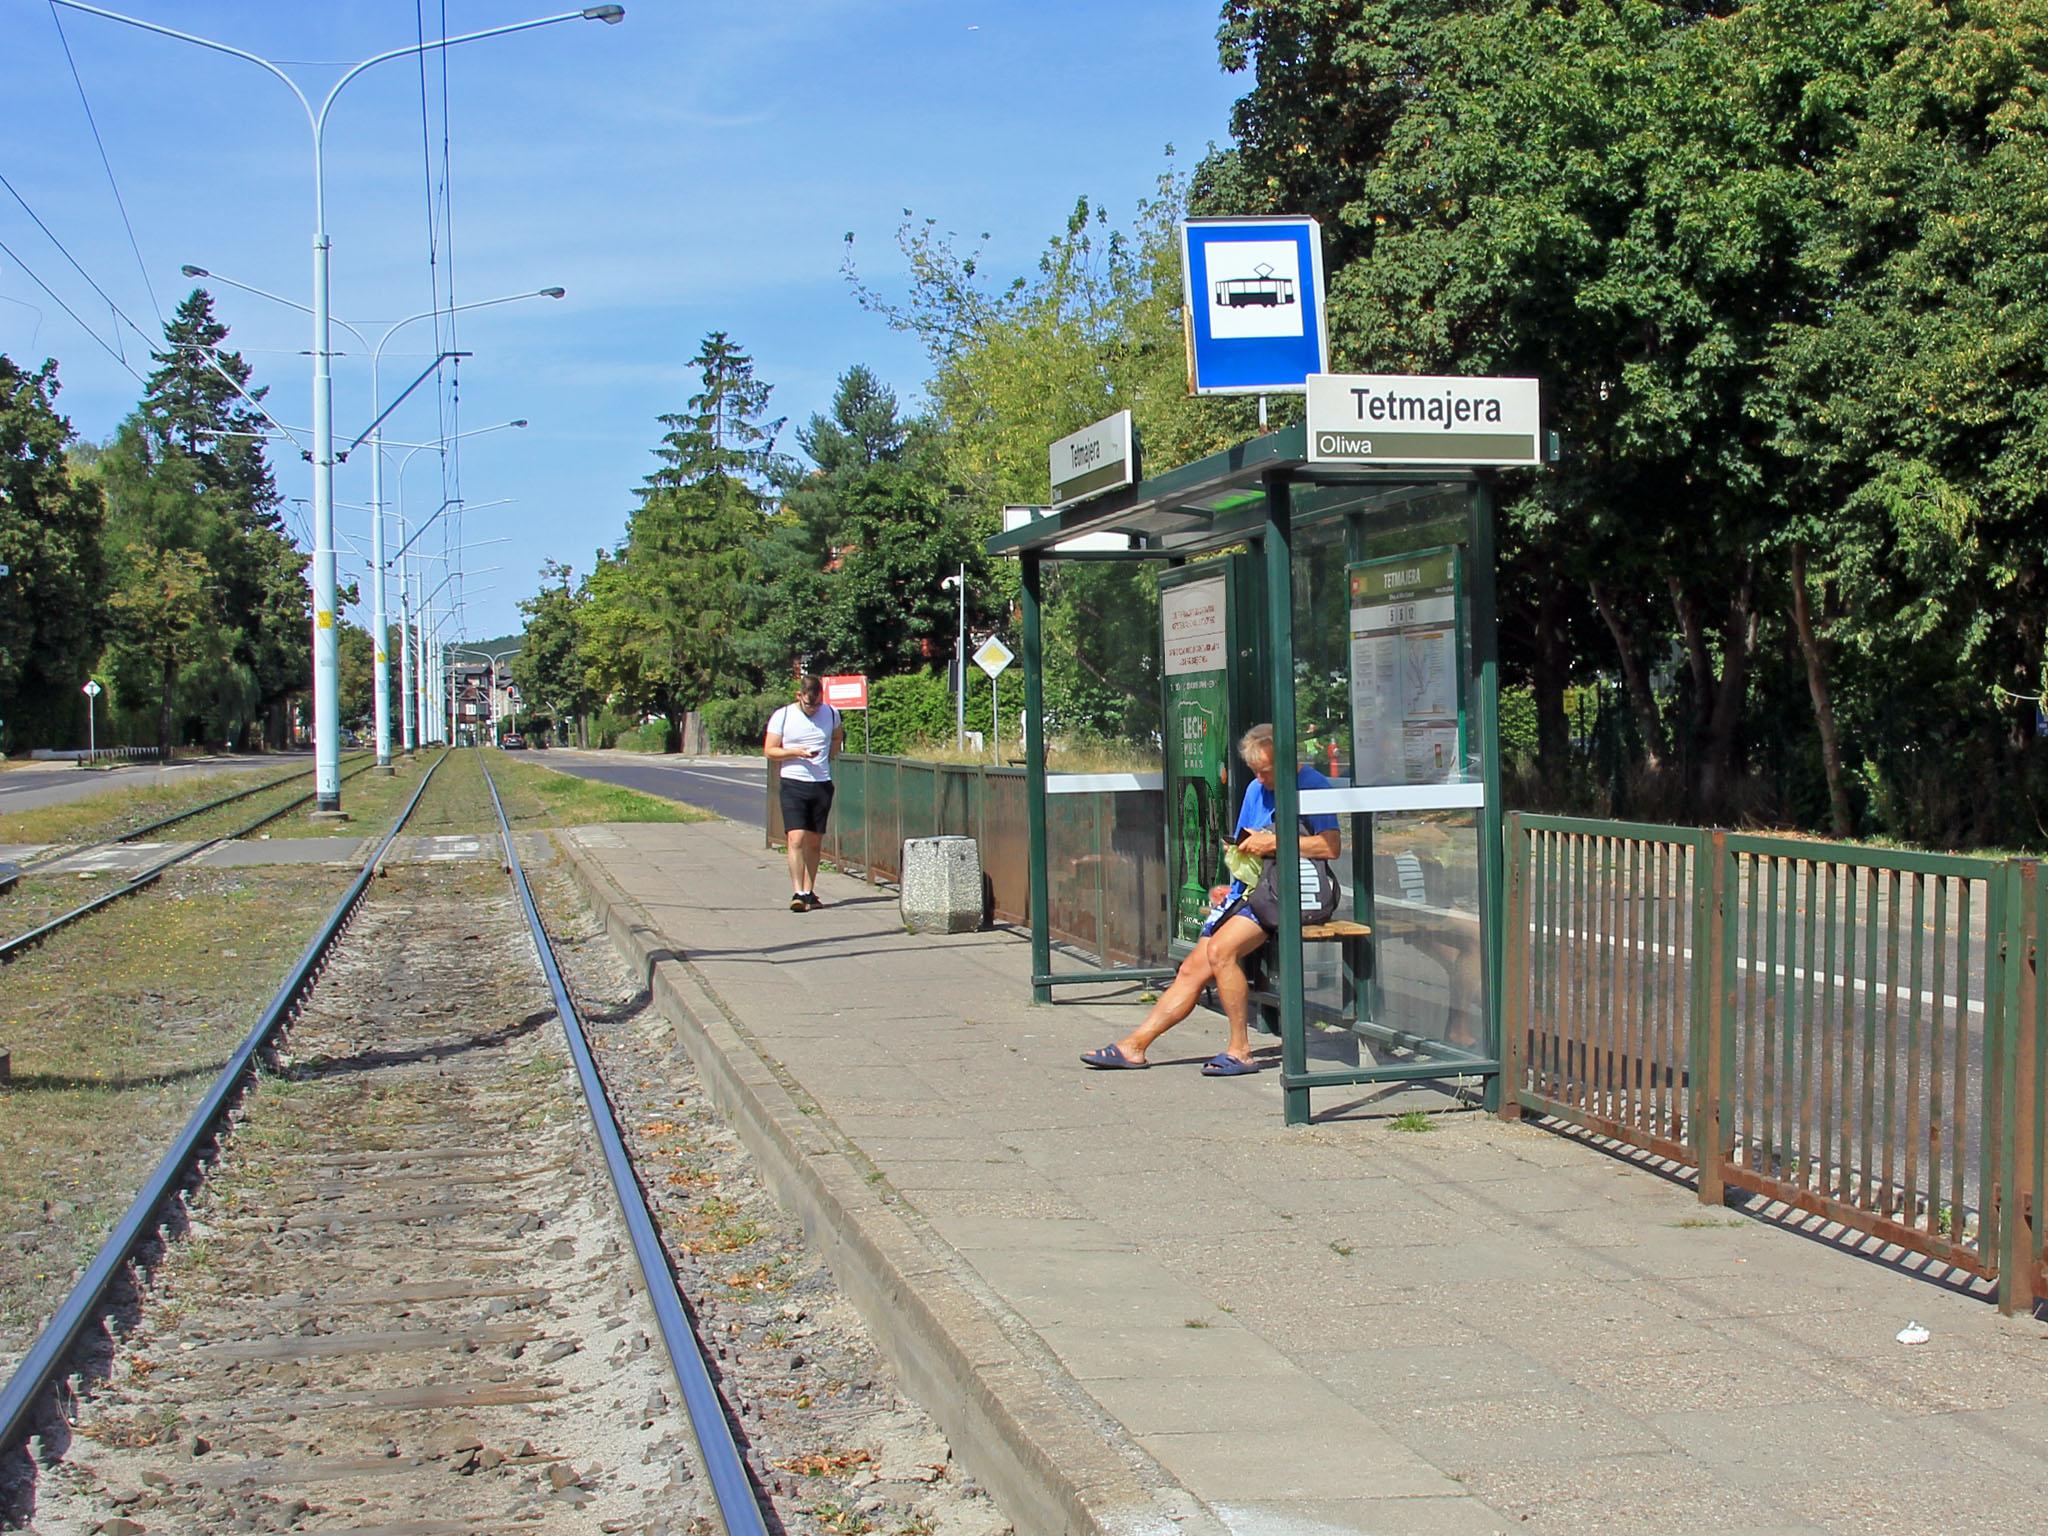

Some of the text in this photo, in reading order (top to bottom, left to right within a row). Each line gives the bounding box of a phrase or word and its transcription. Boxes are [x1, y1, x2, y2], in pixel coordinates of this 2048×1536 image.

[1350, 388, 1502, 430] Tetmajera
[1070, 438, 1100, 470] Tetmajera
[1320, 435, 1372, 454] Oliwa
[1384, 567, 1421, 589] TETMAJERA
[1183, 716, 1203, 739] LECH
